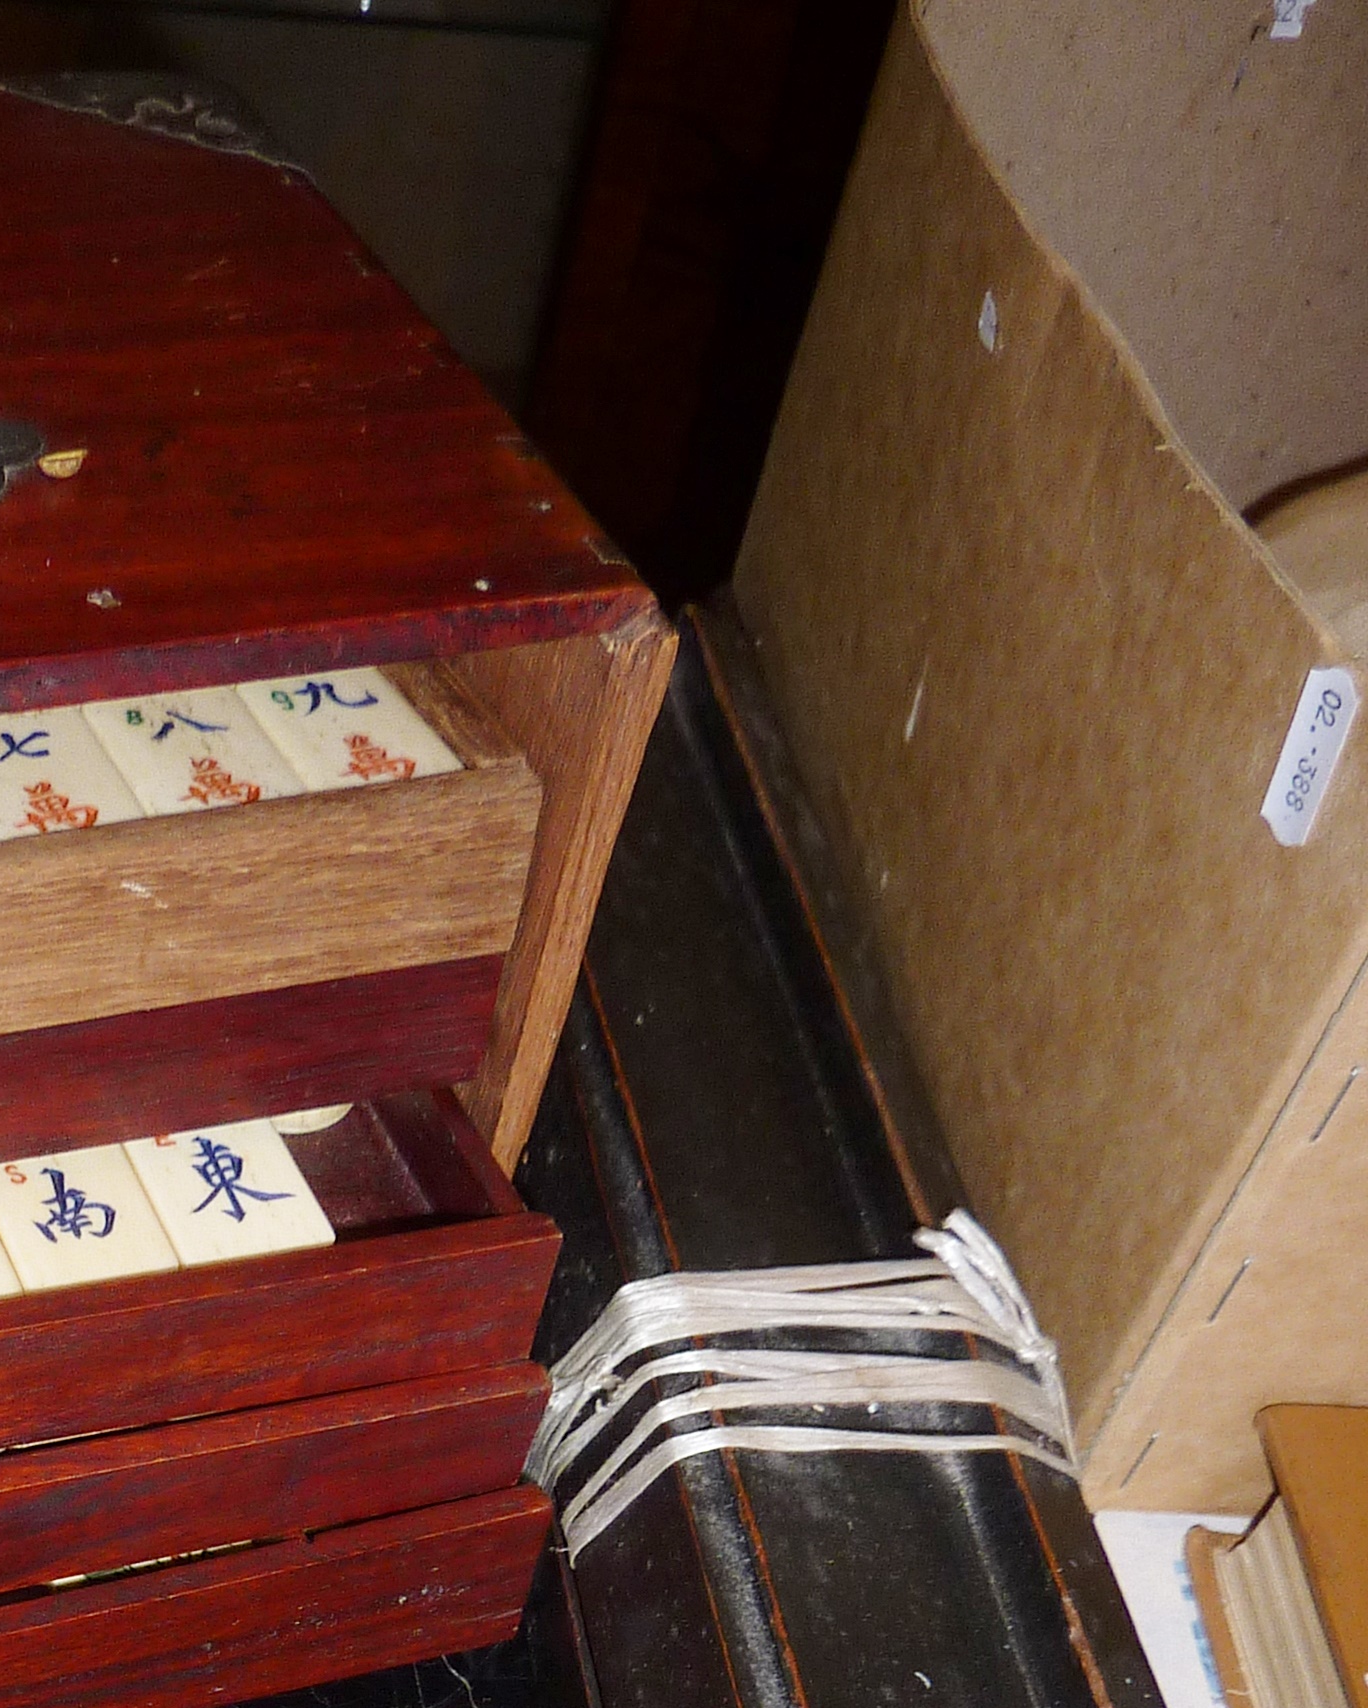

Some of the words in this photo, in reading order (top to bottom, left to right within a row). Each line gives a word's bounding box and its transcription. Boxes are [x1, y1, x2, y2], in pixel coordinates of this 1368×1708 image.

[271, 691, 295, 711] 9
[294, 681, 380, 715] 九
[151, 710, 230, 740] 八
[4, 1165, 28, 1185] S
[190, 1136, 296, 1223] 東
[33, 1168, 116, 1243] 南
